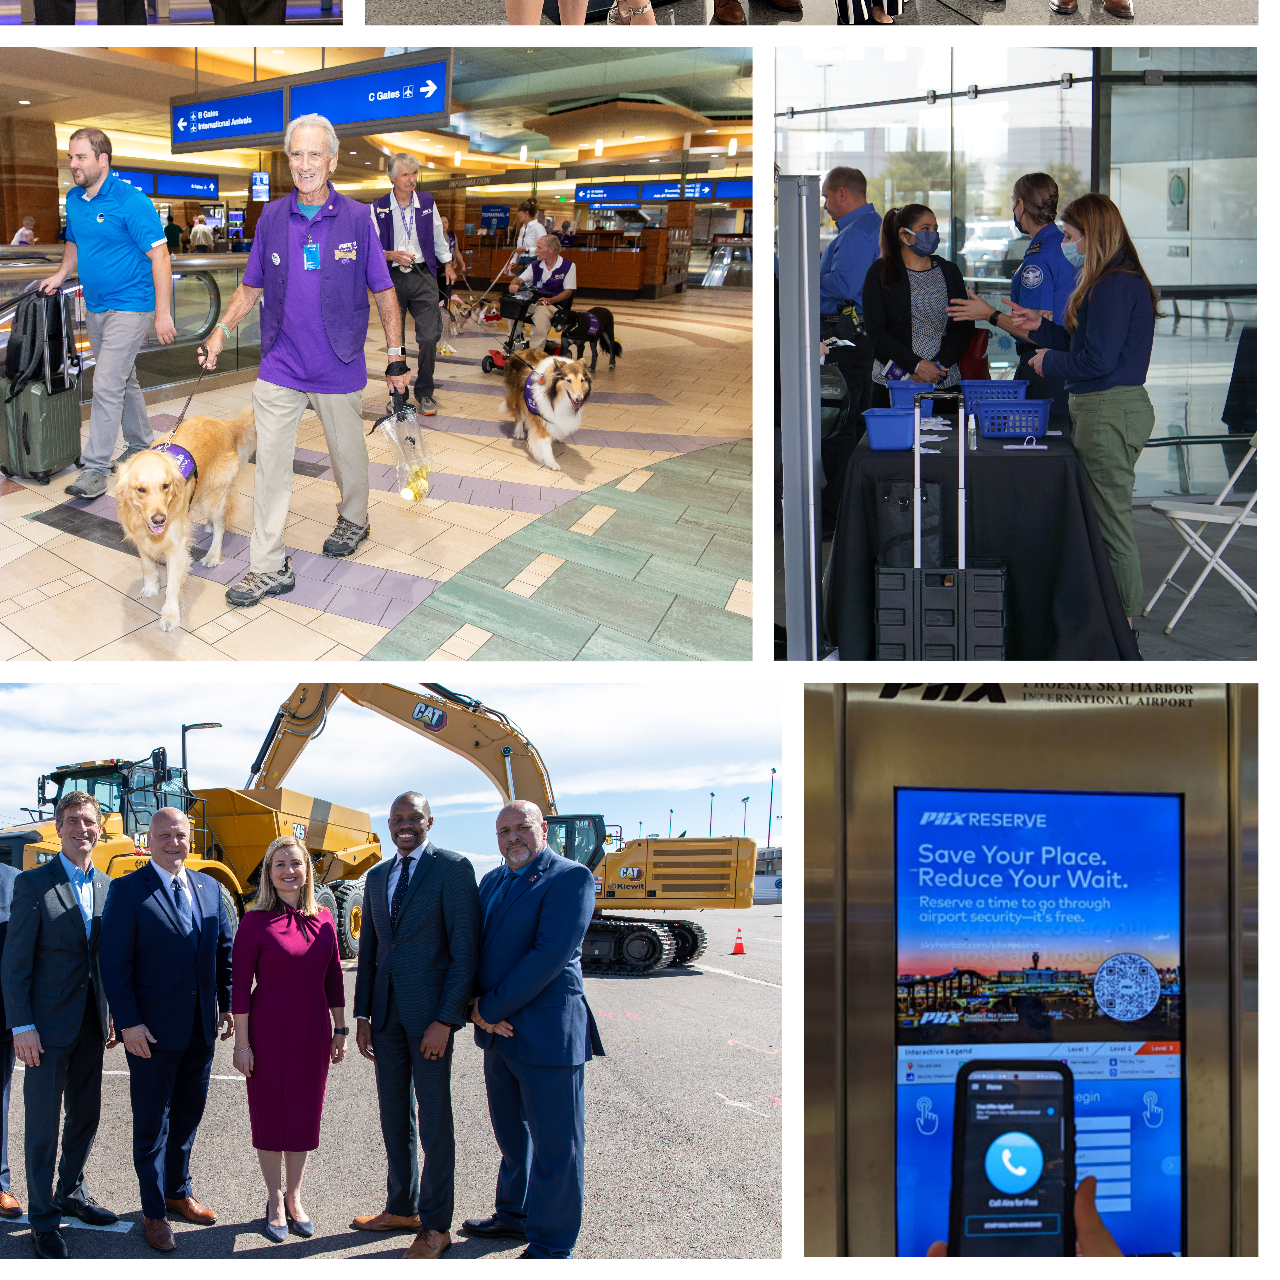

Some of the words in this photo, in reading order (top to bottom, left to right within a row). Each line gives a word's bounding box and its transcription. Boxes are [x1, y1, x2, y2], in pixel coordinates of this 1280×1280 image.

[368, 92, 375, 102] C
[376, 89, 400, 101] Gates
[203, 110, 218, 118] Gates
[198, 119, 230, 130] International
[231, 116, 252, 126] Arrivals
[449, 178, 490, 188] INFORMATION
[1130, 683, 1194, 696] HARBOR
[1022, 692, 1132, 706] INTERNATIONAL
[1136, 696, 1194, 708] AIRPORT
[413, 702, 442, 726] CAT
[920, 812, 967, 826] PHX
[969, 813, 1046, 828] RESERVE
[919, 844, 976, 863] Save
[982, 846, 1034, 864] Your
[1042, 846, 1106, 866] Place.
[620, 868, 639, 878] CAT
[920, 868, 1003, 888] Reduce
[1009, 869, 1061, 888] Your
[1067, 870, 1128, 888] Wait.
[920, 896, 973, 908] Reserve
[976, 900, 984, 908] a
[988, 897, 1018, 908] time
[1022, 898, 1036, 909] to
[1039, 900, 1056, 912] go
[1058, 898, 1110, 912] through
[920, 910, 967, 924] airport
[1056, 910, 1084, 922] free.
[920, 1012, 964, 1024] PHX
[904, 1048, 944, 1056] Interactive
[946, 1048, 972, 1056] Legend
